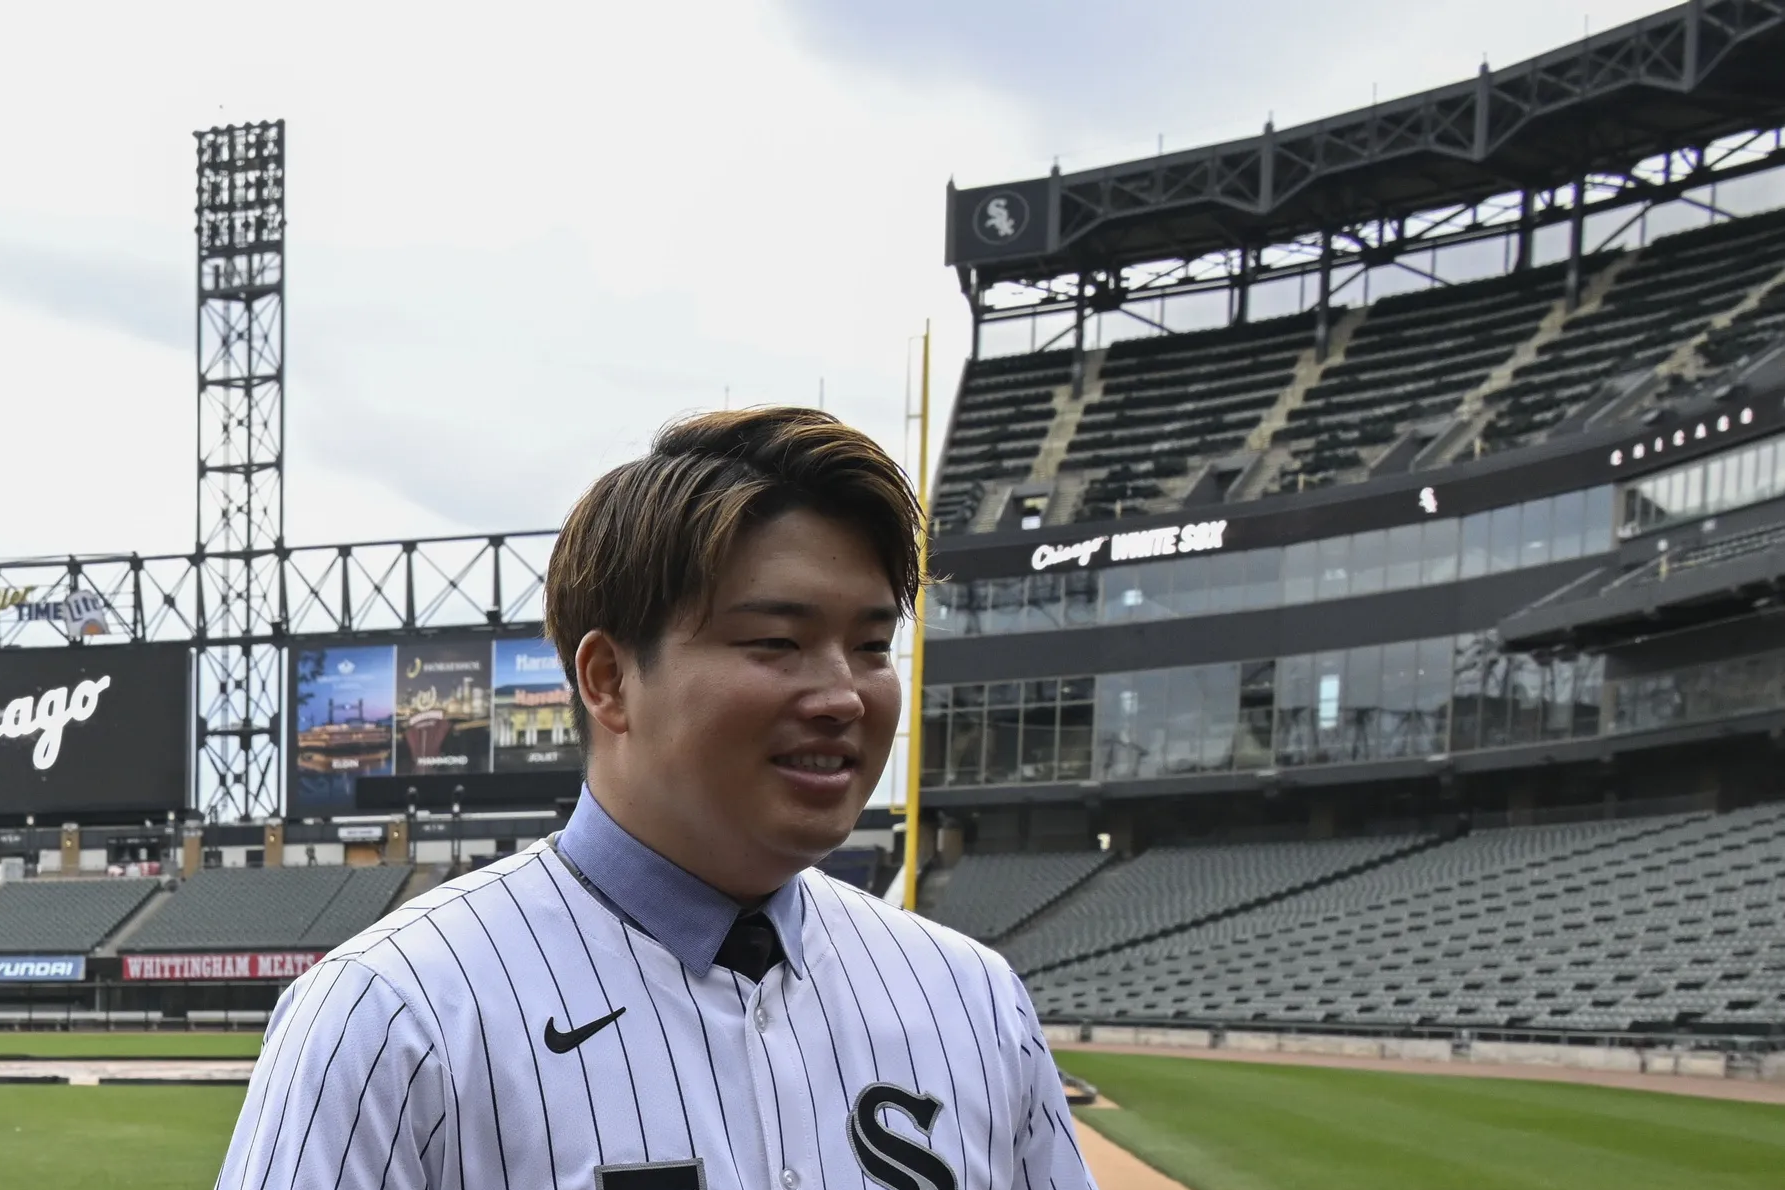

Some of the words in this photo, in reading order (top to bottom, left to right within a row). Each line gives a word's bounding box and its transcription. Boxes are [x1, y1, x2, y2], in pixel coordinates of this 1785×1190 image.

[1178, 520, 1227, 553] SOX
[18, 602, 64, 622] TIME
[68, 595, 102, 623] Lite
[127, 955, 250, 978] WHITTINGHAM
[258, 953, 315, 977] MEATS
